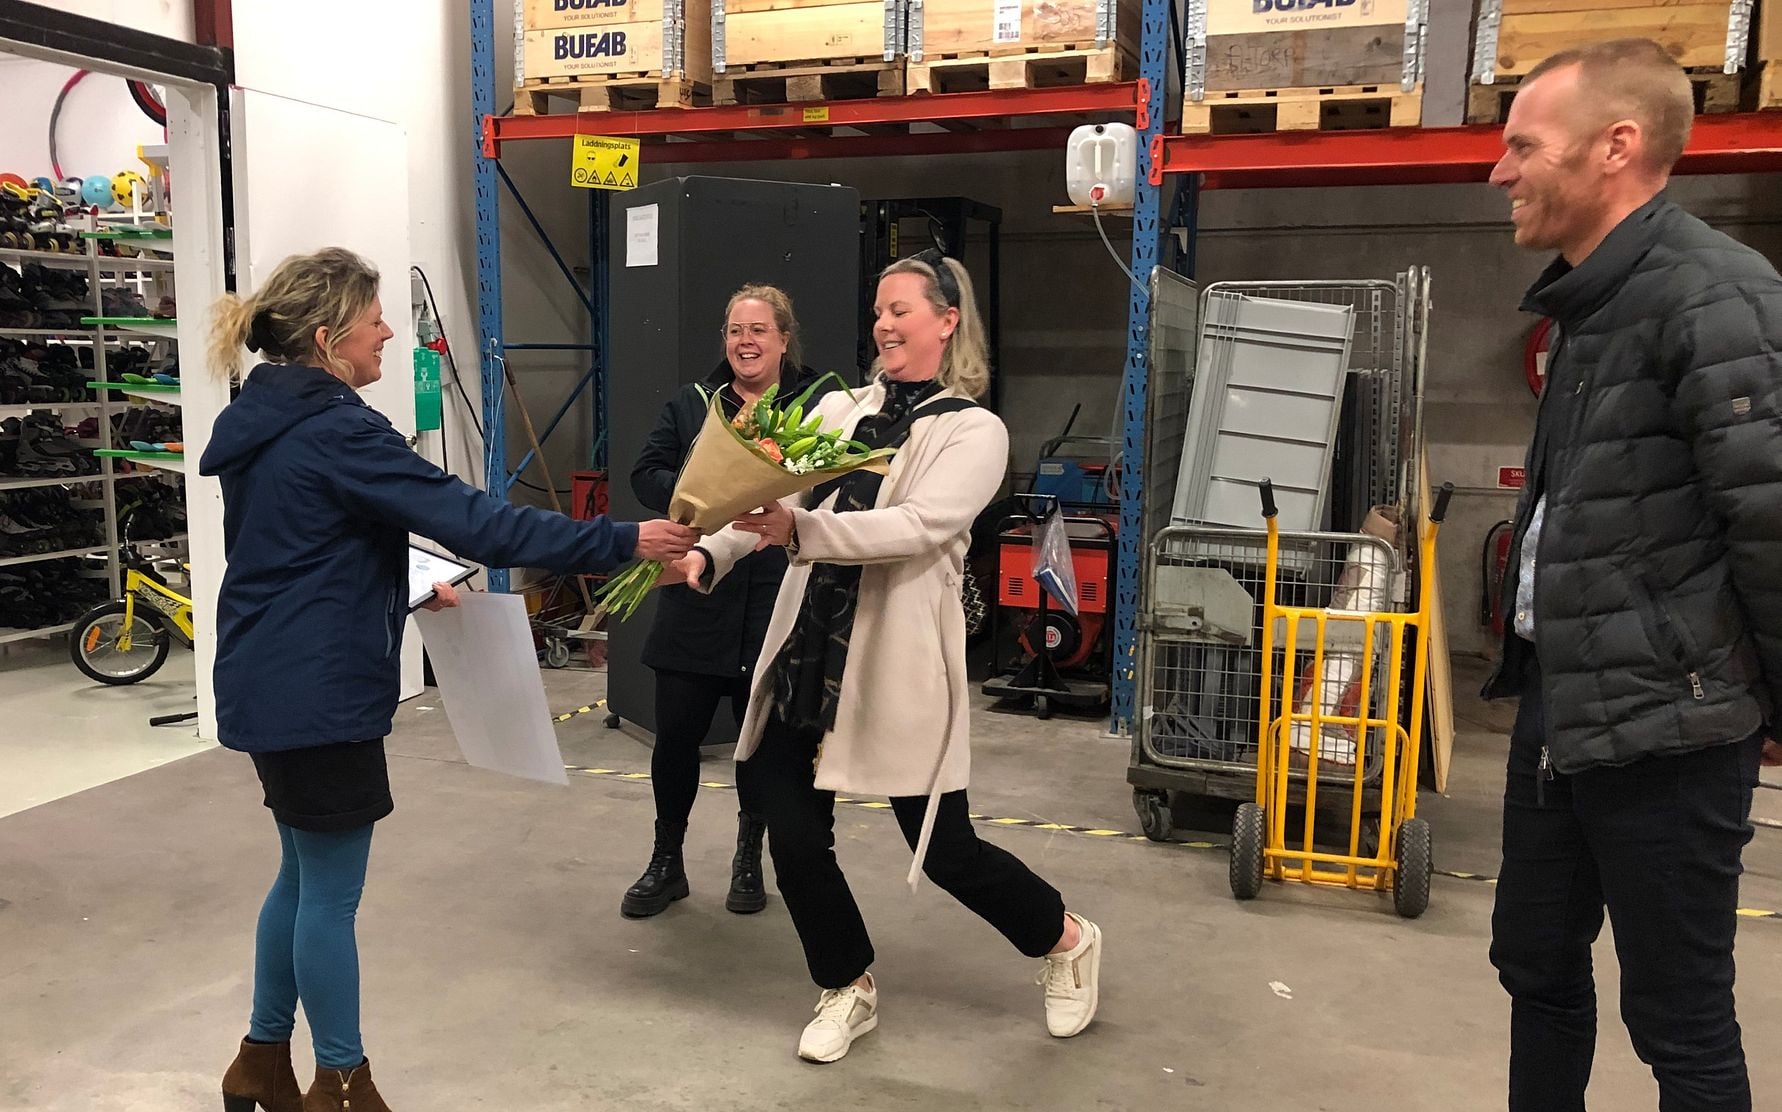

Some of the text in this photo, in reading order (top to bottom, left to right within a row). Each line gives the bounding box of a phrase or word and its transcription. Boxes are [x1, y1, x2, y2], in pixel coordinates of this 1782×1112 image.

[580, 11, 617, 20] SOLUTIONIST
[1265, 12, 1342, 25] YOUR SOLUTIONIST
[554, 31, 627, 60] BUFAB
[580, 61, 617, 69] SOLUTIONIST
[581, 139, 631, 150] Laddningsplats
[1510, 470, 1526, 478] SKU
